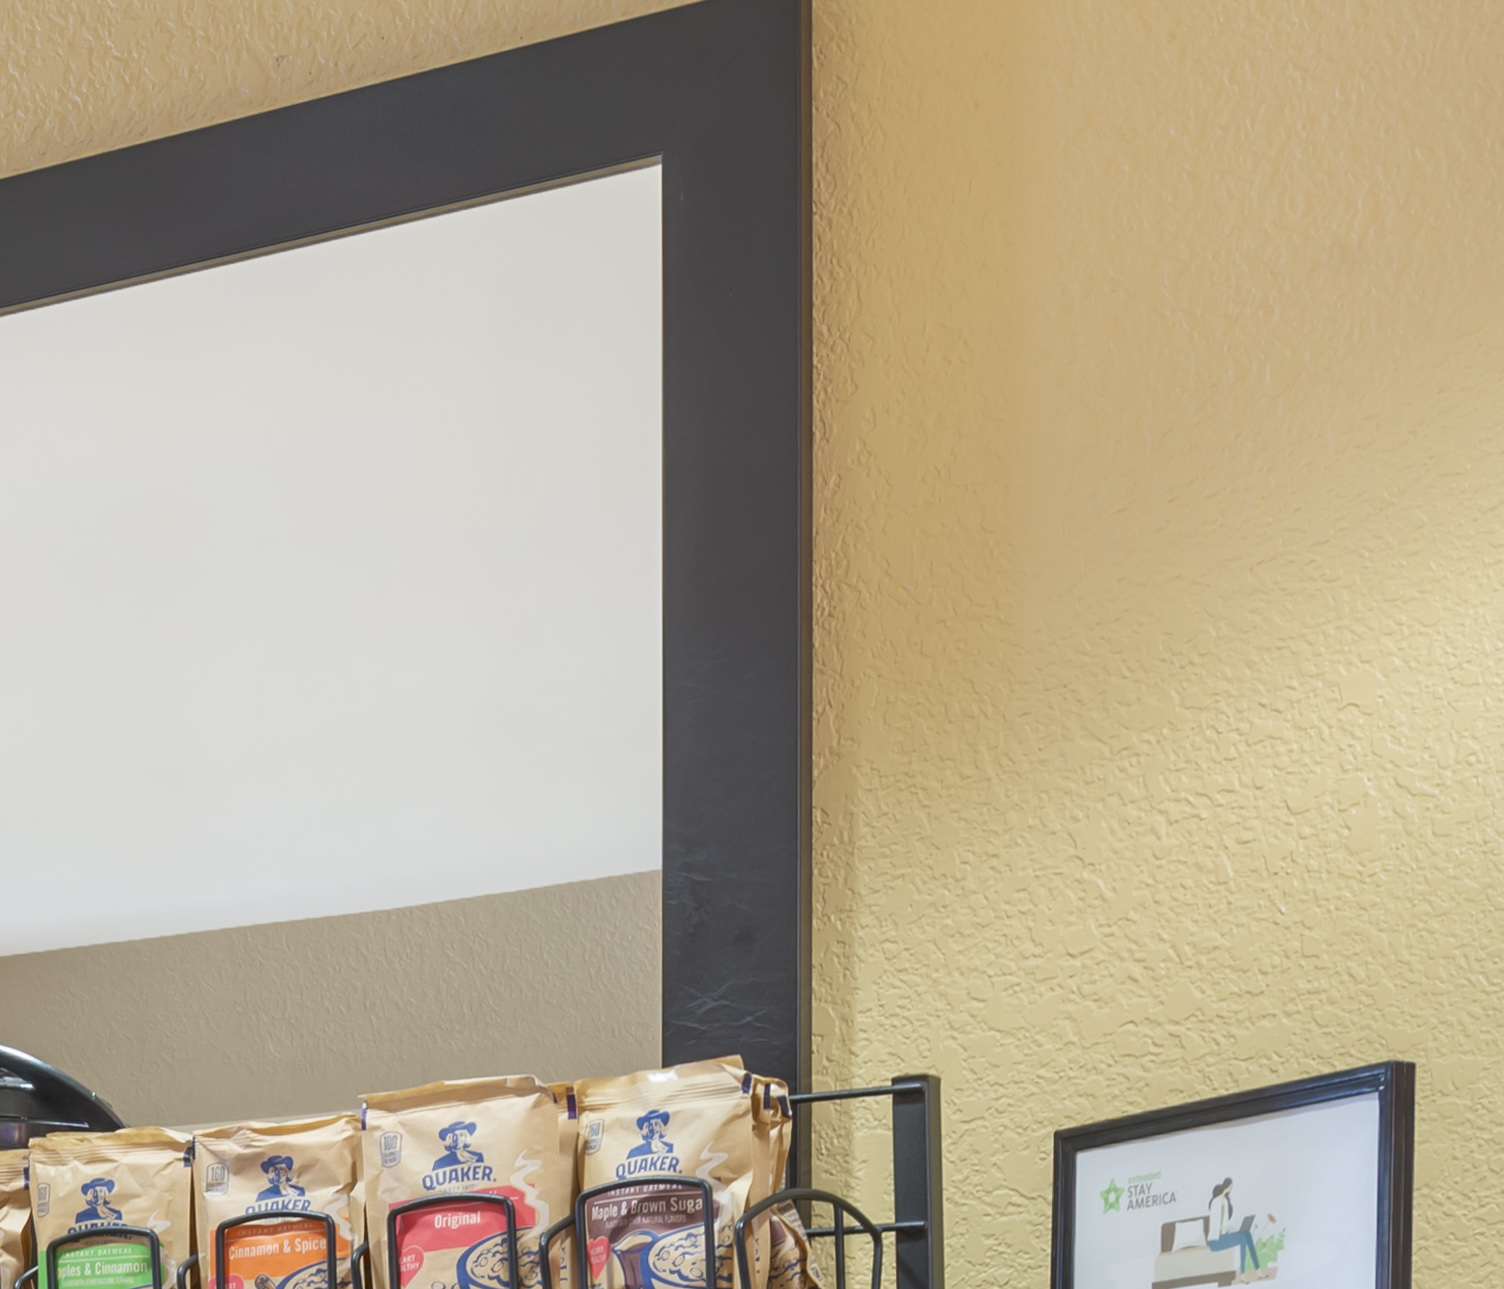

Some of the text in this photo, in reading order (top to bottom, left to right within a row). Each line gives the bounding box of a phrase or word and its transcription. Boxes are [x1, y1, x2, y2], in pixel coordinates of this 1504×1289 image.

[616, 1156, 679, 1180] QUAKER
[1127, 1170, 1162, 1183] extended
[422, 1165, 493, 1191] QUAKER
[1127, 1183, 1153, 1198] STAY
[620, 1203, 628, 1216] &
[631, 1199, 667, 1215] Brown
[670, 1197, 703, 1212] Suga
[1127, 1191, 1177, 1211] AMERICA
[434, 1211, 481, 1229] Original
[228, 1238, 327, 1260] Cinnamon & Spice
[84, 1261, 148, 1276] & Cinnamon
